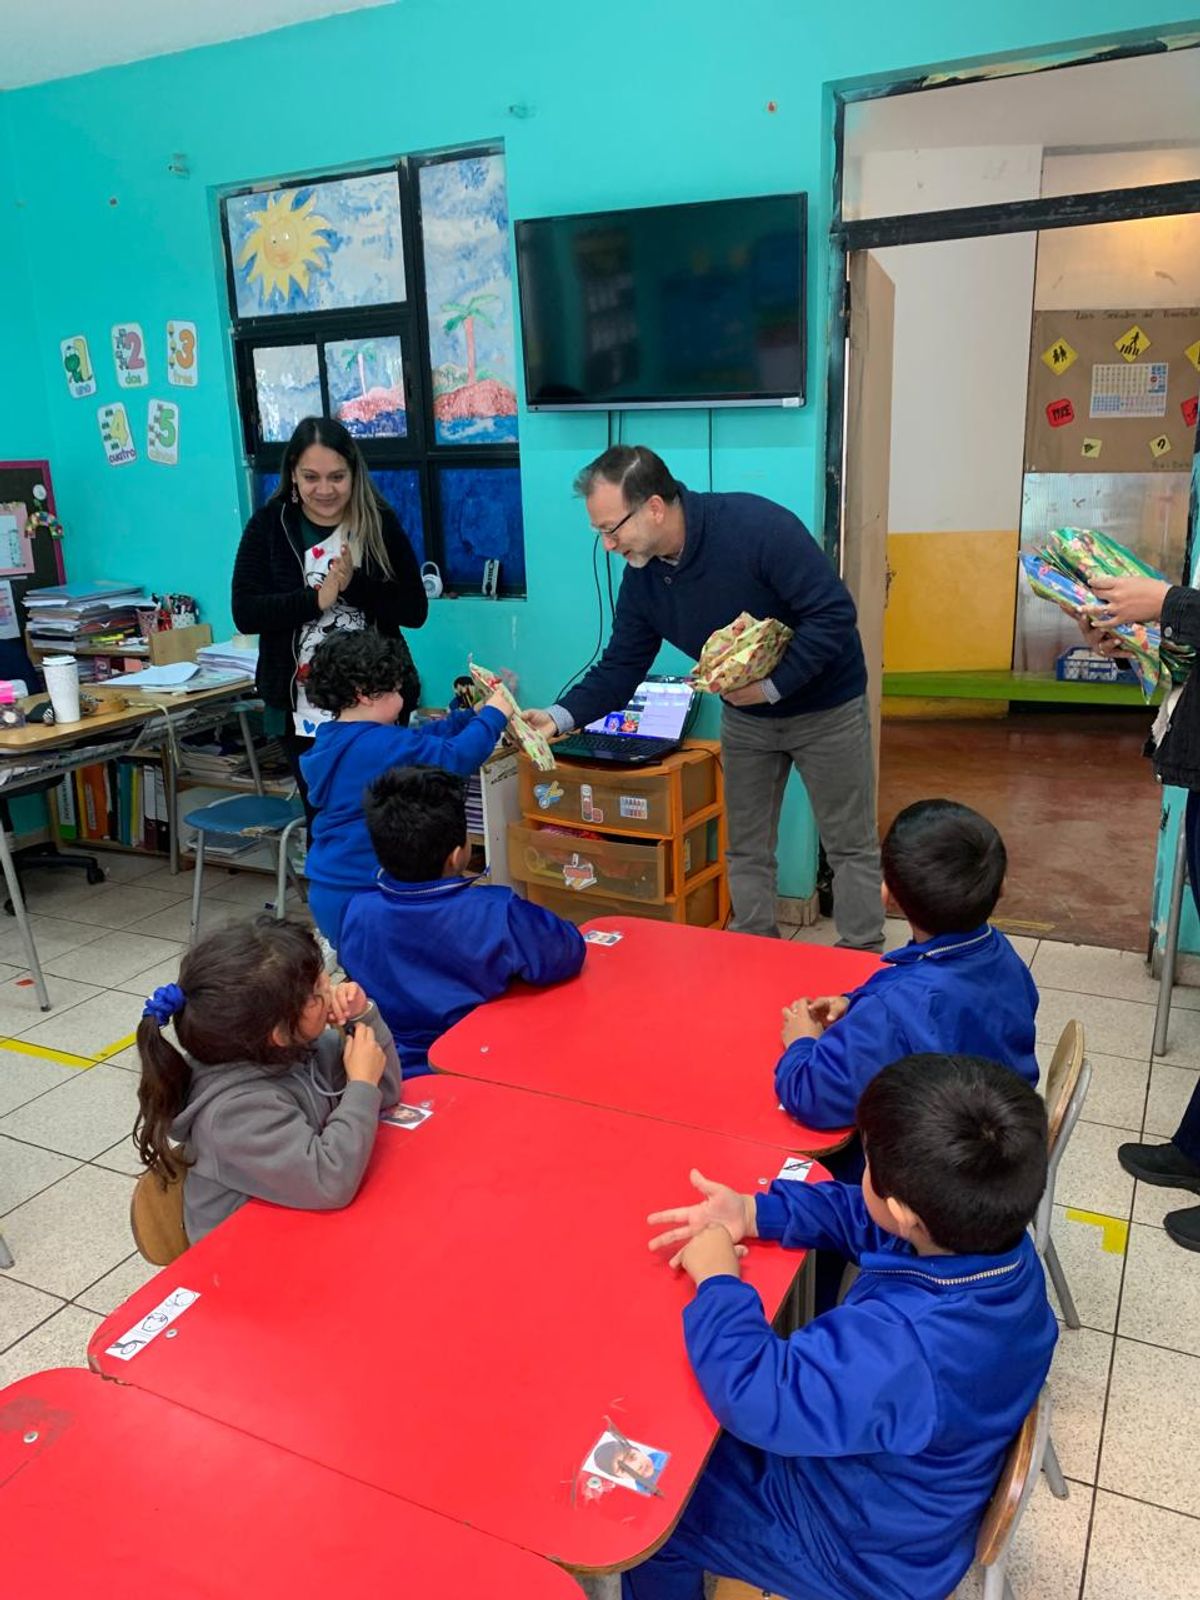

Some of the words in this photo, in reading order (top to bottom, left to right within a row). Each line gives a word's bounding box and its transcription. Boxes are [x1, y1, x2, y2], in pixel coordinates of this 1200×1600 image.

[125, 331, 145, 370] 2
[176, 329, 195, 369] 3
[75, 384, 91, 396] uno
[125, 372, 142, 385] dos
[110, 408, 128, 447] 4
[158, 408, 176, 448] 5
[109, 448, 136, 463] cuatro
